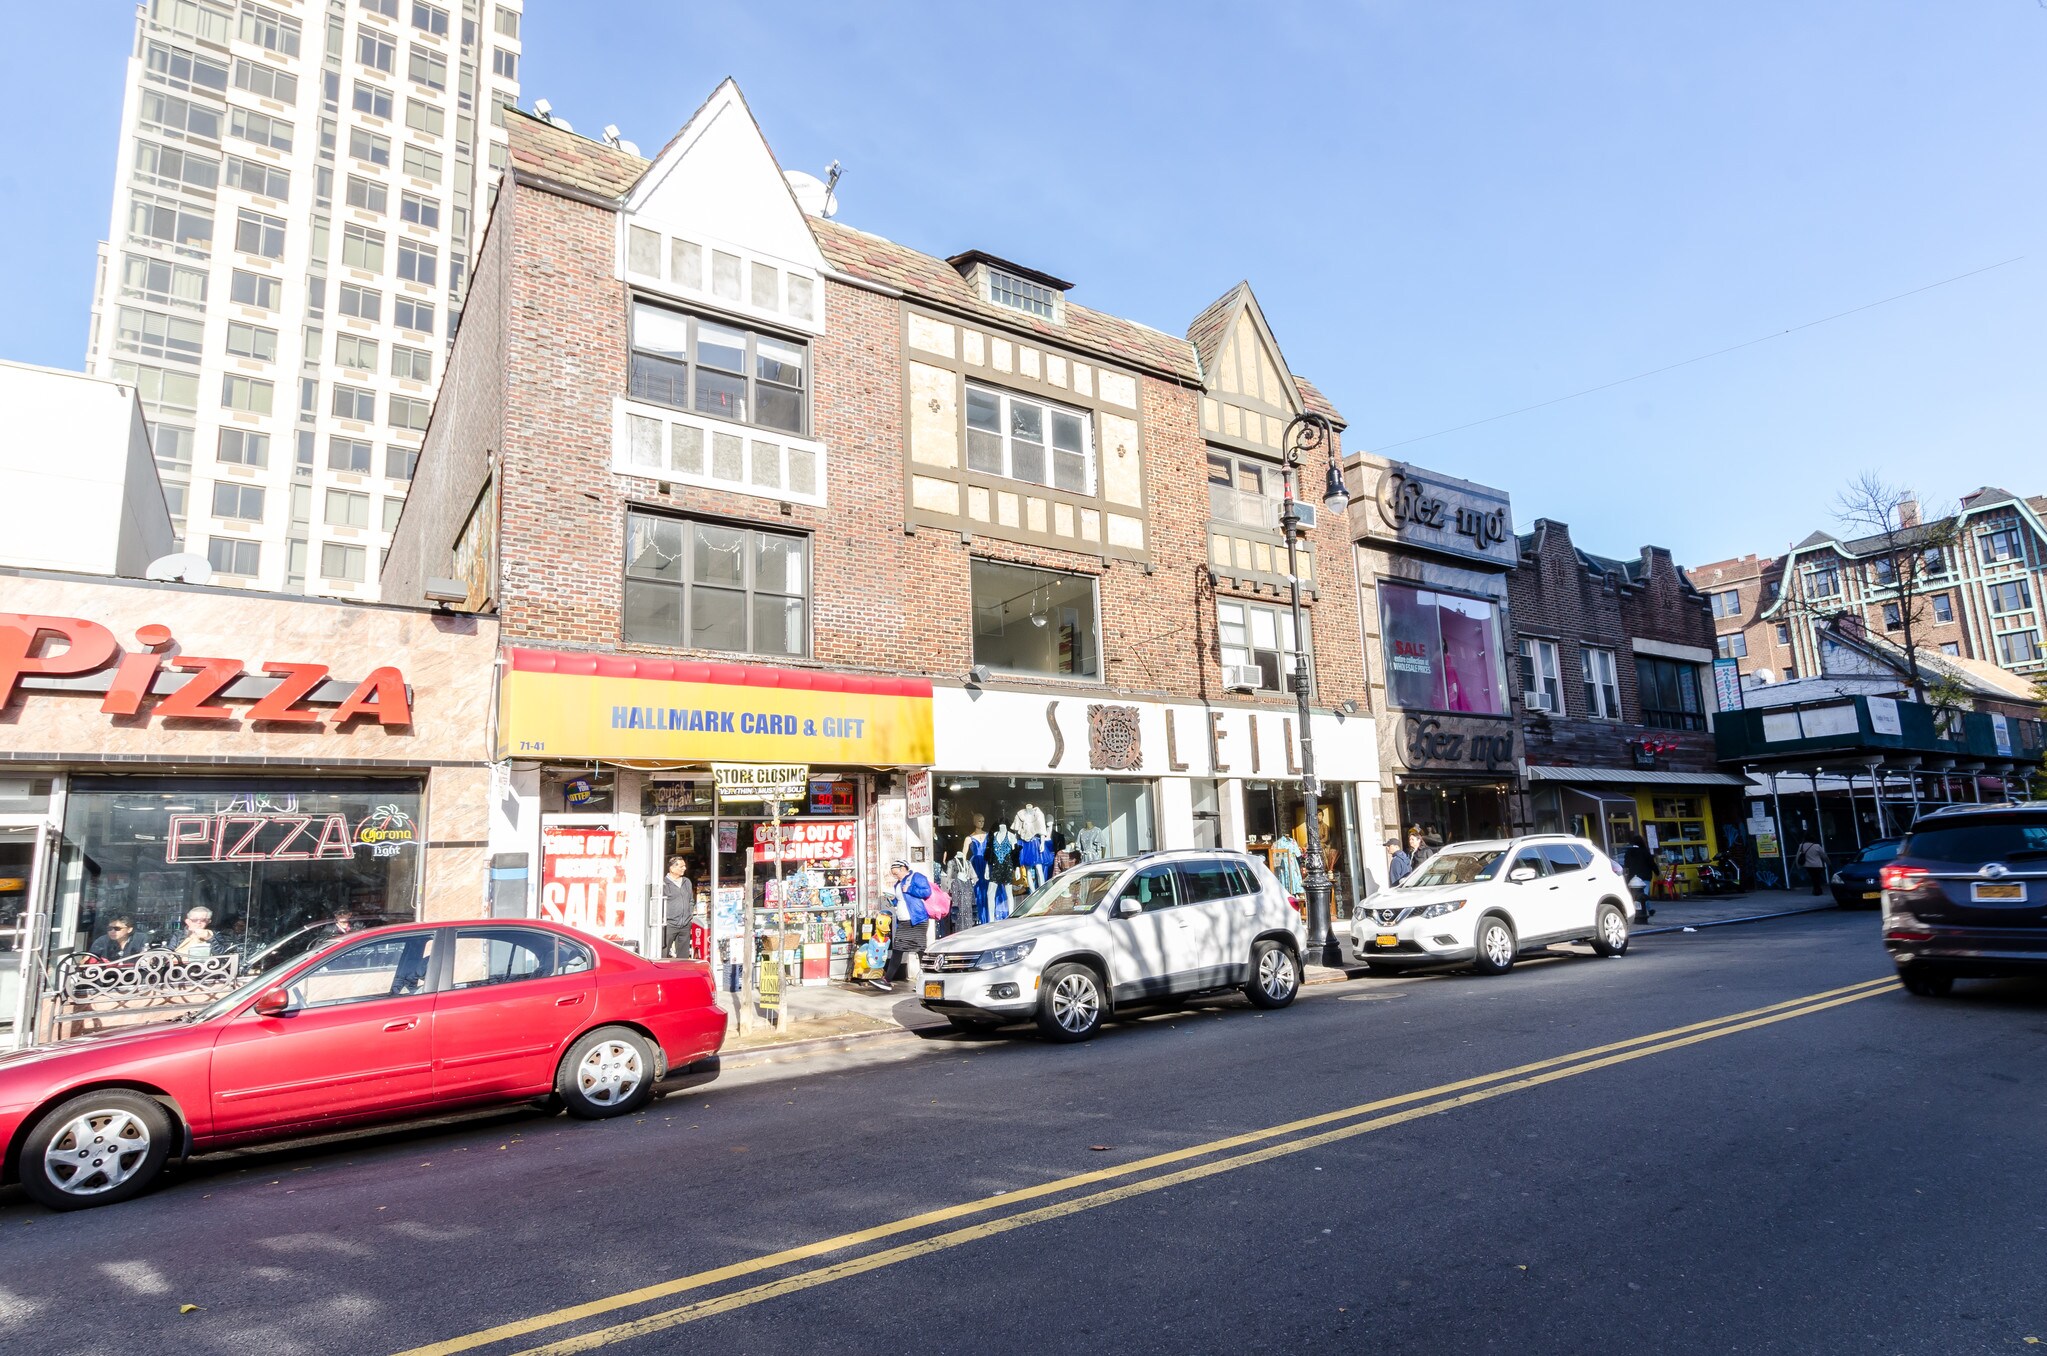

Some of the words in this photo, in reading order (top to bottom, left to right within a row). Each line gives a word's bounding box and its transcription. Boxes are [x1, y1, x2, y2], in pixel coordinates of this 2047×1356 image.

[1376, 467, 1448, 530] Chez
[1455, 507, 1507, 550] moi
[1395, 640, 1425, 657] SALE
[611, 706, 735, 733] HALLMARK
[740, 711, 798, 736] CARD
[803, 717, 818, 737] &
[822, 716, 866, 739] GIFT
[519, 741, 545, 751] 71-41
[1395, 713, 1464, 769] Chez
[1470, 730, 1514, 771] moi
[715, 769, 754, 784] STORE
[757, 768, 806, 784] CLOSING
[659, 780, 686, 802] Quick
[840, 793, 853, 805] 71
[909, 785, 927, 800] PHOTO
[667, 791, 693, 813] Draw
[167, 814, 354, 864] PIZZA
[360, 827, 413, 844] Corona
[756, 826, 805, 842] GOING
[806, 825, 835, 841] OUT
[837, 824, 853, 841] OF
[373, 845, 401, 857] Light
[542, 882, 627, 930] SALE
